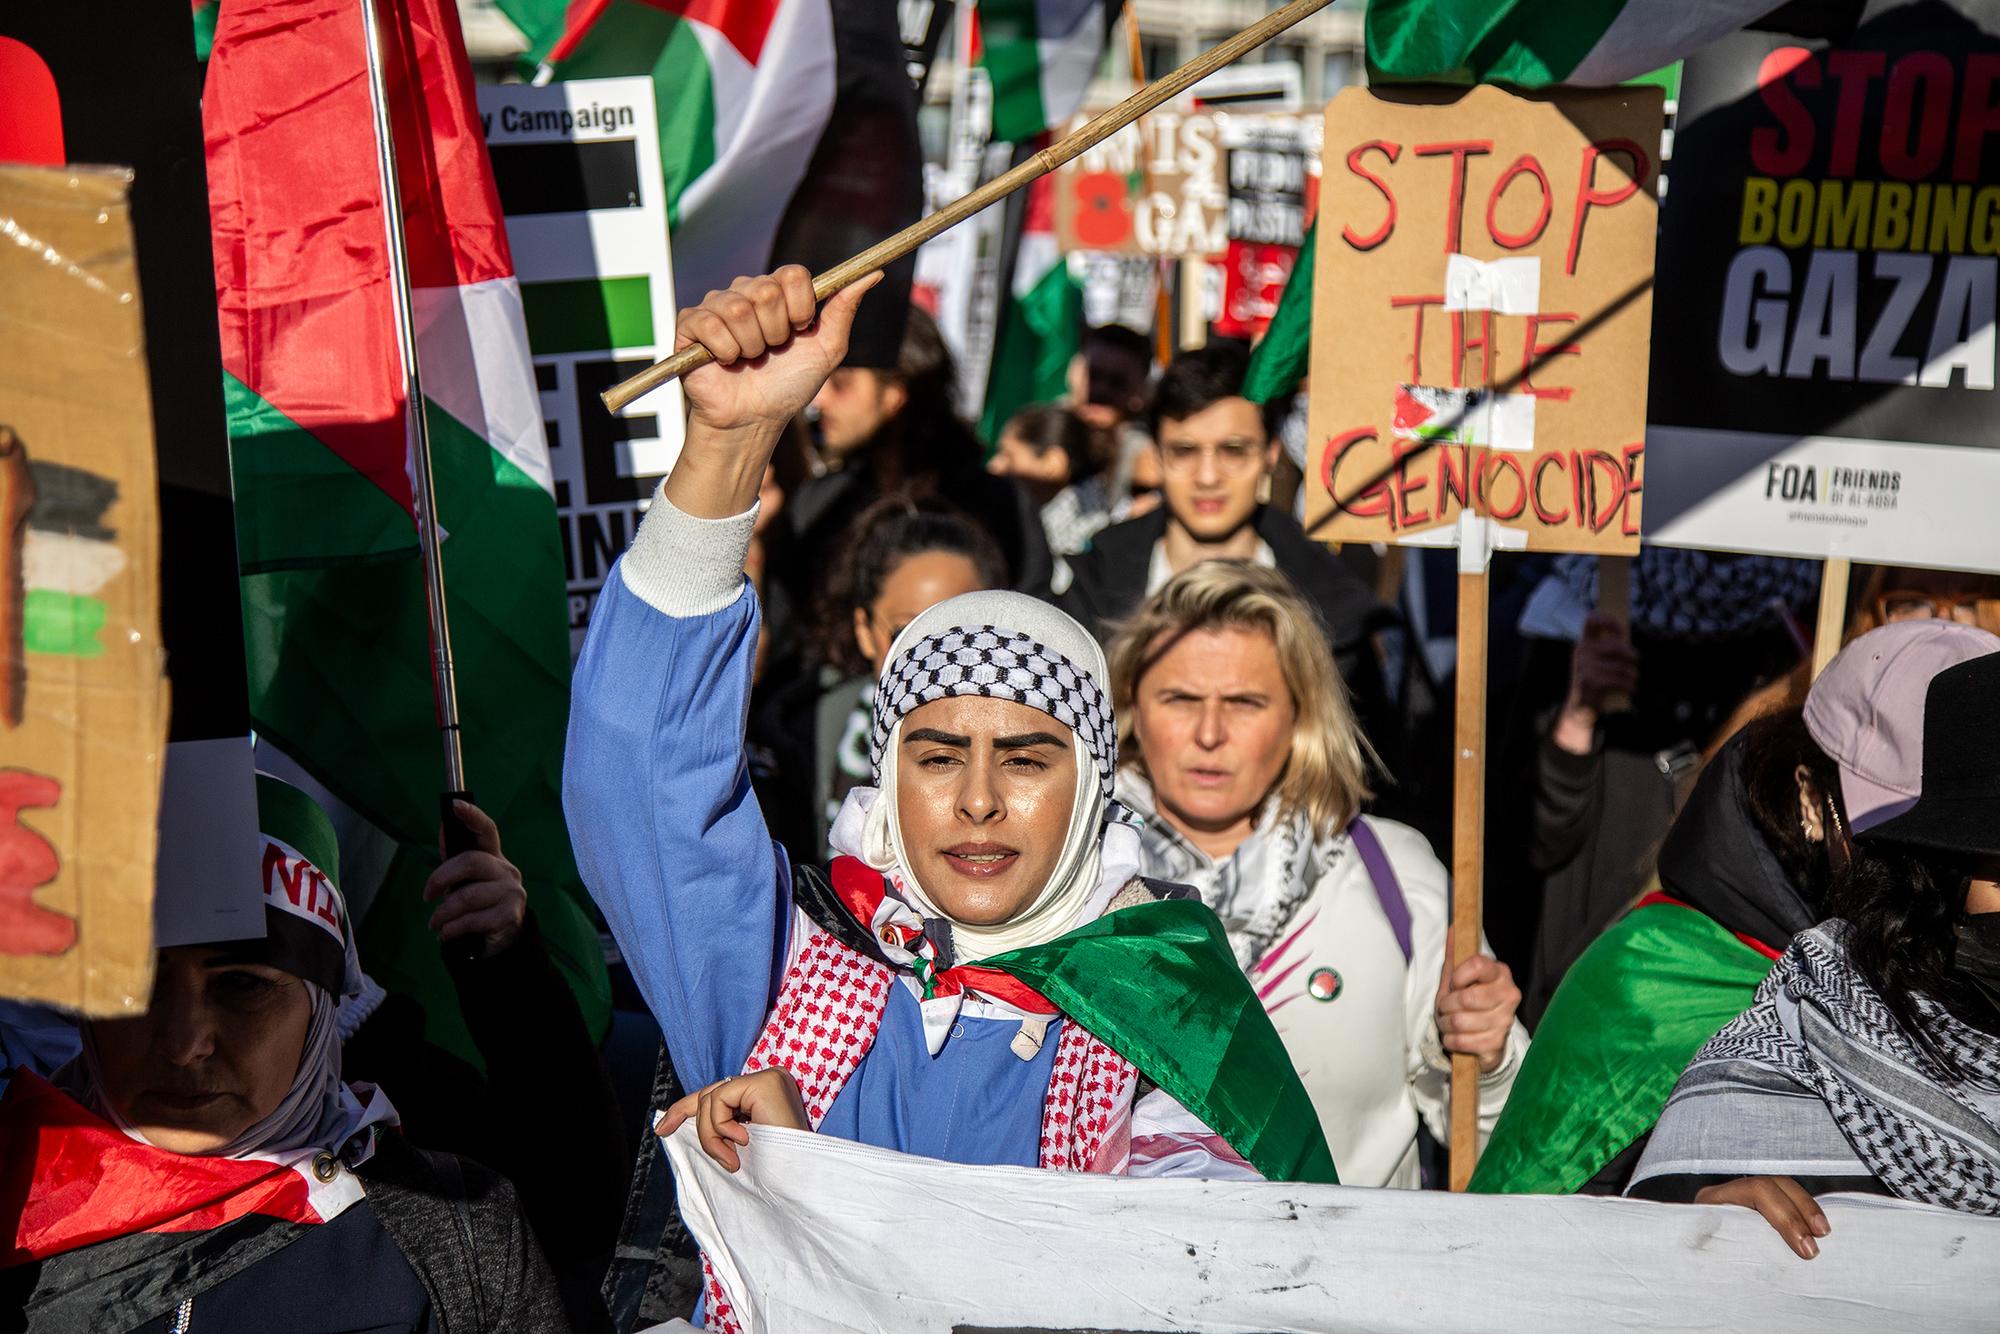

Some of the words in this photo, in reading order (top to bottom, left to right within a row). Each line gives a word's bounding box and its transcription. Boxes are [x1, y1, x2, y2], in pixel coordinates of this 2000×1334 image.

[501, 102, 634, 134] Campaign
[1750, 46, 2000, 183] STOP
[1341, 138, 1651, 276] STOP
[1738, 176, 2000, 256] BOMBING
[1391, 295, 1582, 402] THE
[1717, 245, 1998, 391] GAZA
[1320, 426, 1646, 537] GENOCIDE
[1765, 462, 1817, 503] FOA
[1831, 490, 1844, 505] OF
[1833, 467, 1901, 492] FRIENDS
